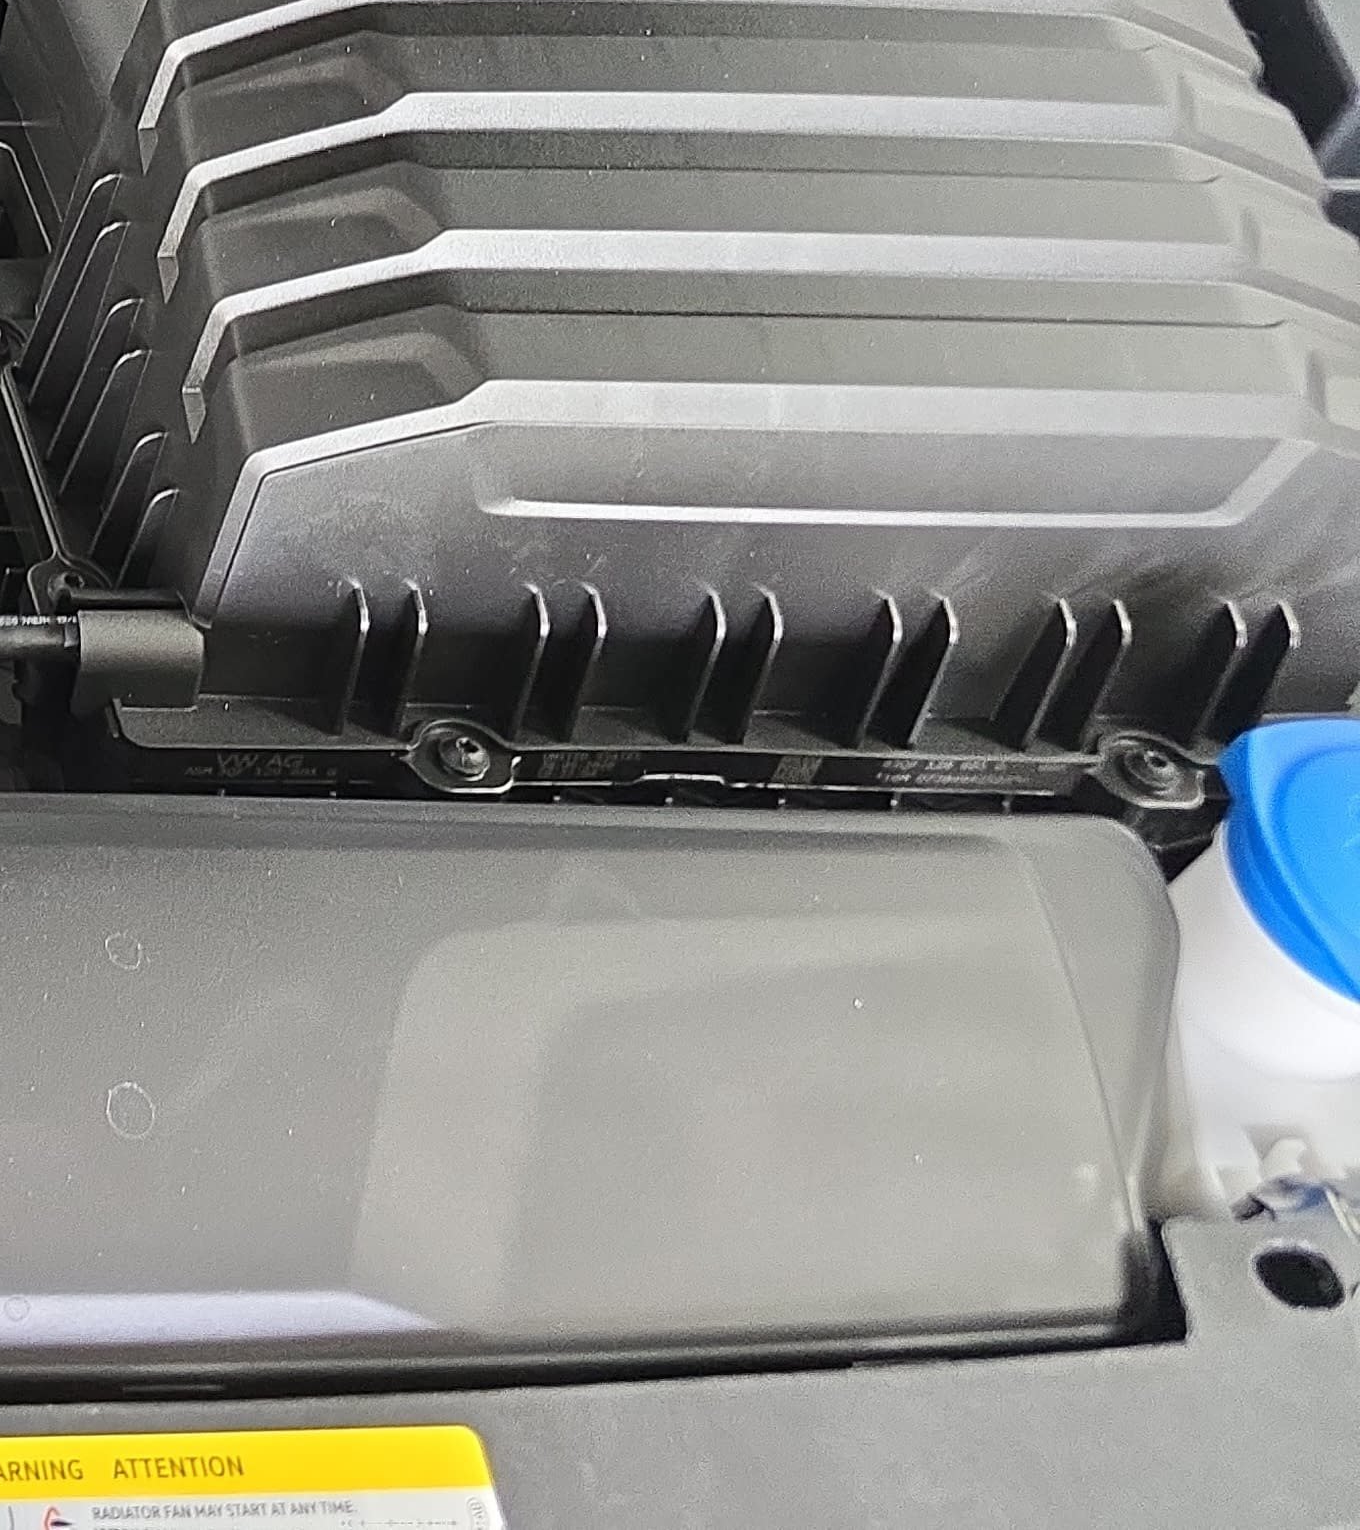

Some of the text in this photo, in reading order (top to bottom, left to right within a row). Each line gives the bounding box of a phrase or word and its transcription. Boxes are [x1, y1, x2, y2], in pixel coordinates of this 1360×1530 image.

[112, 1455, 245, 1480] ATTENTION
[92, 1504, 160, 1520] RADIATOR
[162, 1504, 192, 1519] FAN
[194, 1502, 223, 1518] MAY
[225, 1502, 266, 1518] START
[270, 1501, 287, 1516] AT
[289, 1501, 317, 1516] ANY
